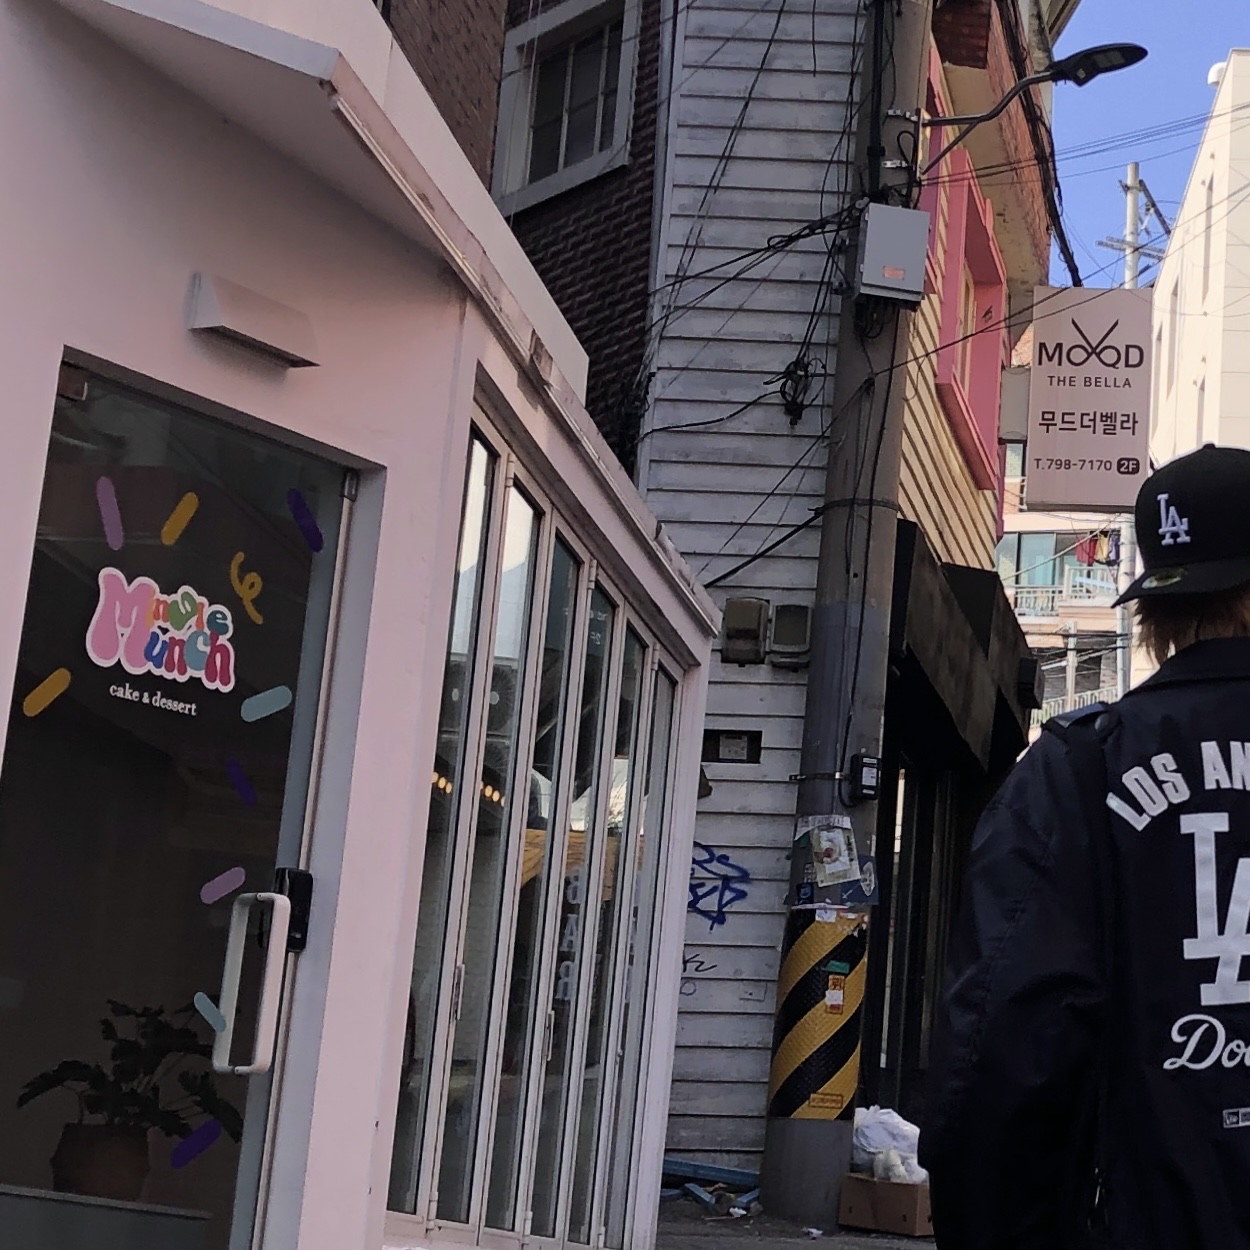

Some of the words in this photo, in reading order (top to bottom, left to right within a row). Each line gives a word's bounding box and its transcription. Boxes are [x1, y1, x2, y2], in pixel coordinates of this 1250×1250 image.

[1047, 375, 1076, 387] THE
[1083, 376, 1132, 389] BELLA
[1038, 410, 1139, 436] 무드더벨라
[1034, 458, 1112, 471] T.798-7170
[1120, 460, 1138, 473] 2F
[1157, 493, 1191, 545] LA
[109, 683, 139, 701] cake
[142, 692, 150, 704] &
[152, 690, 197, 716] dessert
[1106, 753, 1191, 832] LOS
